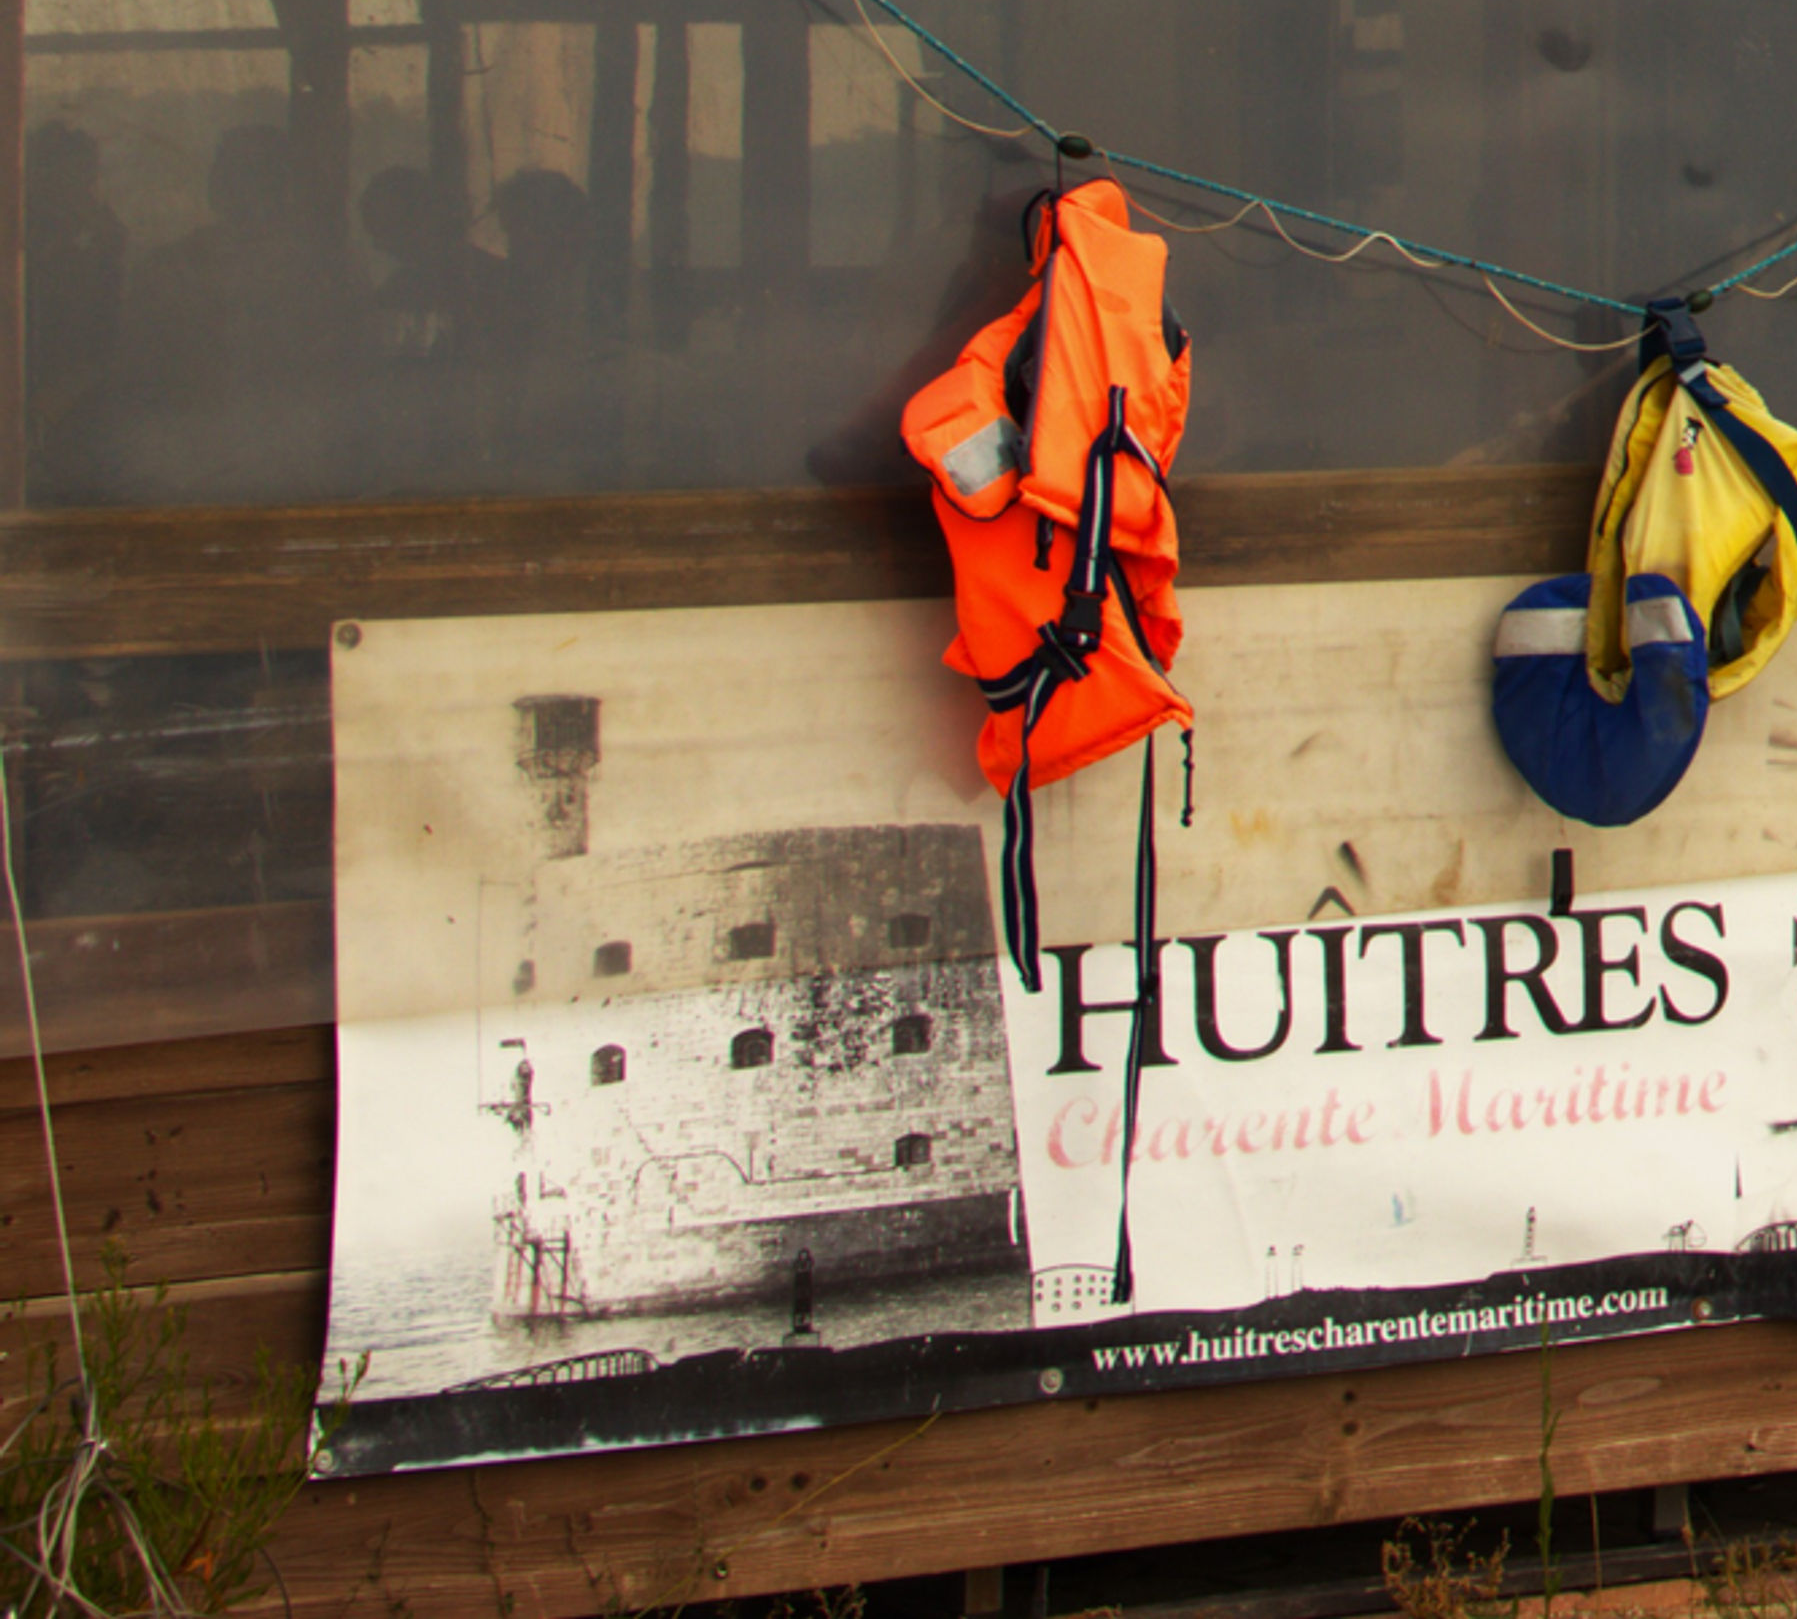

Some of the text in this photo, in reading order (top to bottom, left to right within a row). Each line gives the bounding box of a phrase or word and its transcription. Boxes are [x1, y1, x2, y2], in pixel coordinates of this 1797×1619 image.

[1046, 1062, 1728, 1169] Charente Maritime
[1092, 1286, 1669, 1372] www.huitrescharentemaritime.com
